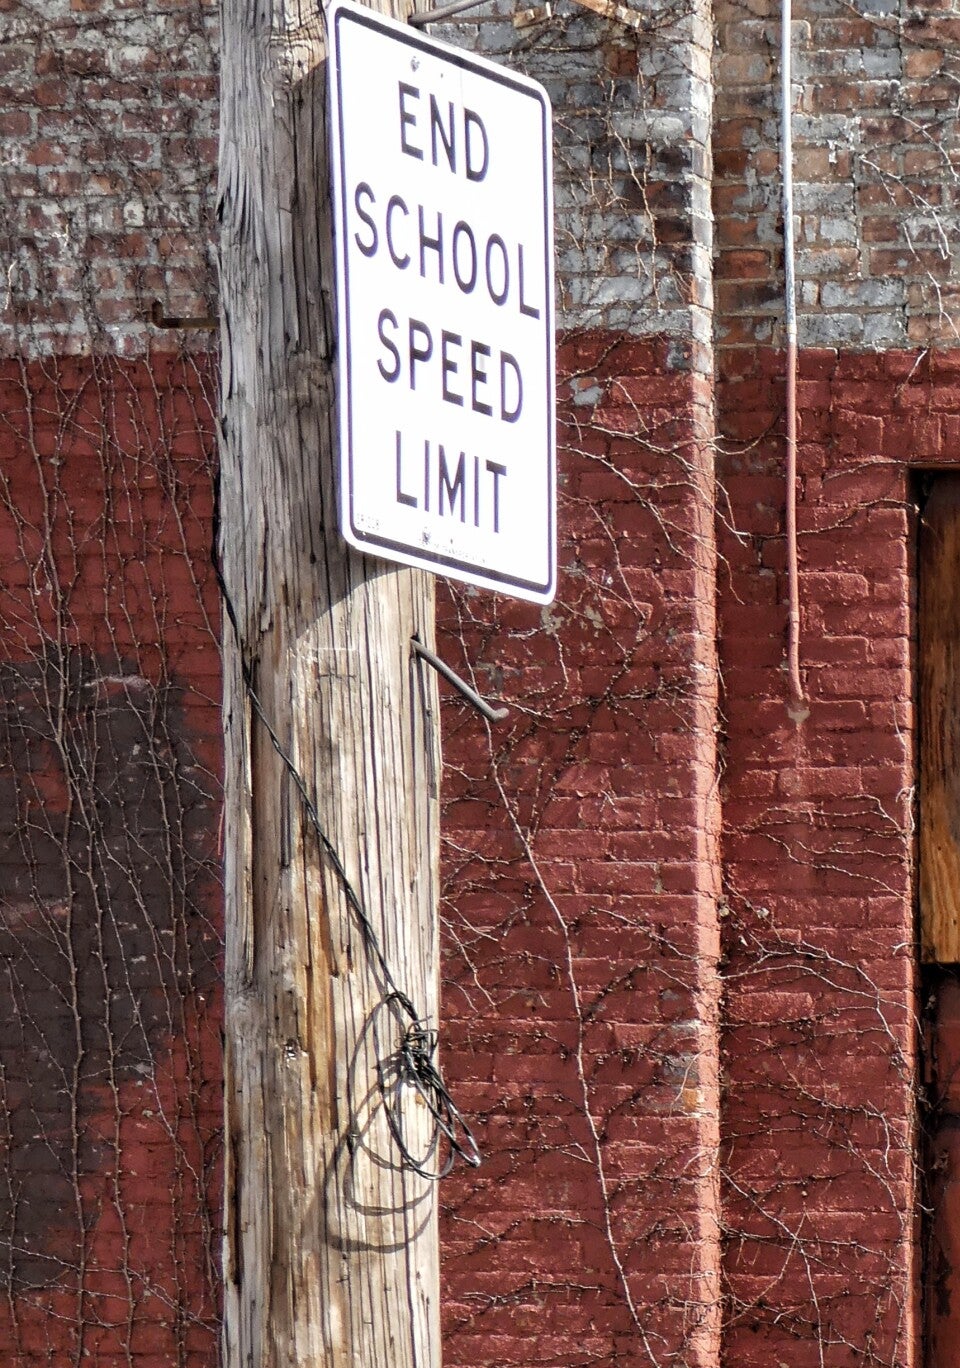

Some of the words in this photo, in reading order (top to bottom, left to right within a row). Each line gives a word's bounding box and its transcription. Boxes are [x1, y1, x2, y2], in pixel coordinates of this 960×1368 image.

[398, 80, 489, 183] END
[354, 181, 540, 320] SCHOOL
[376, 308, 523, 424] SPEED
[395, 430, 507, 534] LIMIT
